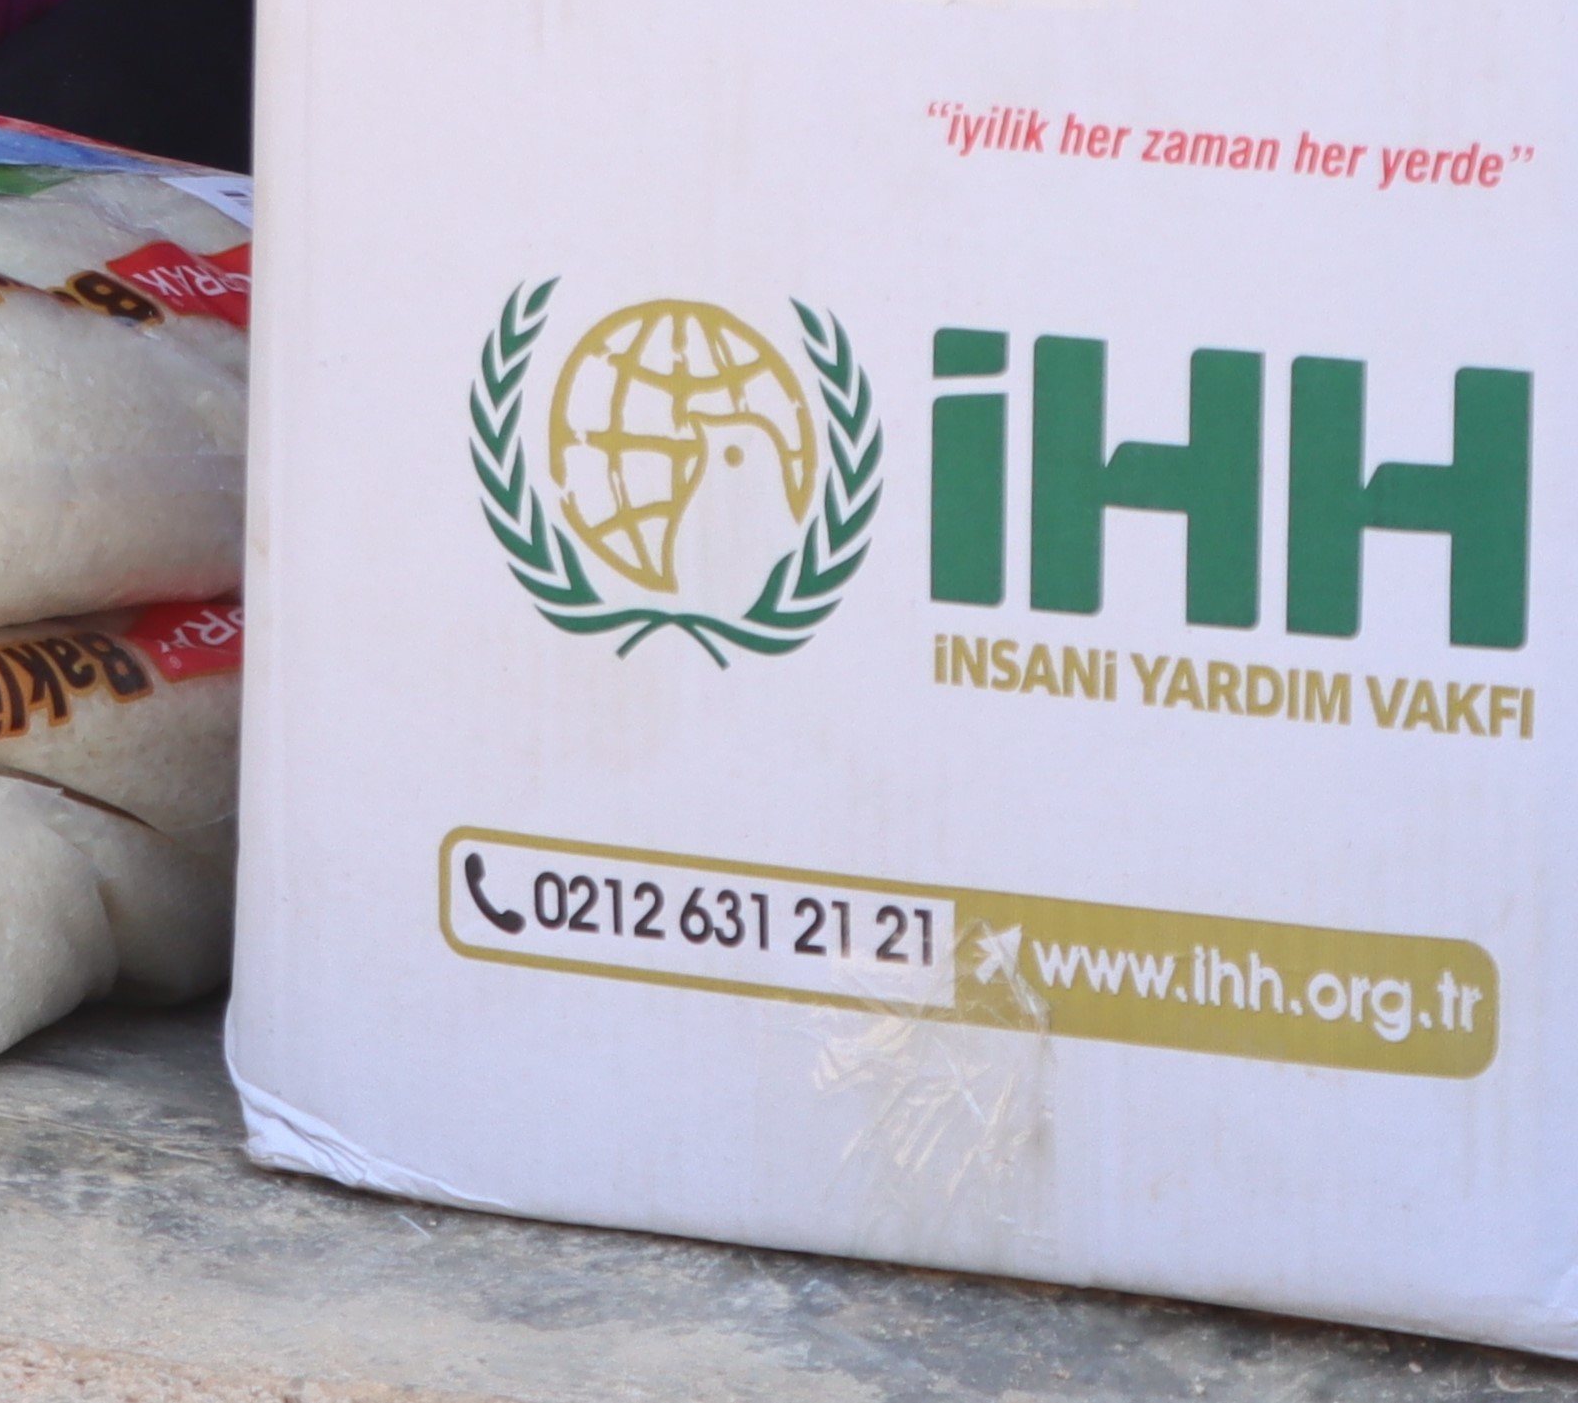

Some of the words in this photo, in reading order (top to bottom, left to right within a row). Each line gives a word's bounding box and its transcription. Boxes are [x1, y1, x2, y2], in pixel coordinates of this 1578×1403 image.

[1060, 113, 1132, 164] her
[1142, 128, 1280, 174] zaman
[1294, 132, 1368, 179] her
[1136, 653, 1351, 725] YARDIM
[1367, 672, 1535, 740] VAKFI
[531, 871, 665, 943] 0212
[679, 887, 772, 950] 631
[793, 897, 852, 957] 21
[875, 906, 935, 965] 21
[1032, 935, 1482, 1042] www.ihh.org.tr
